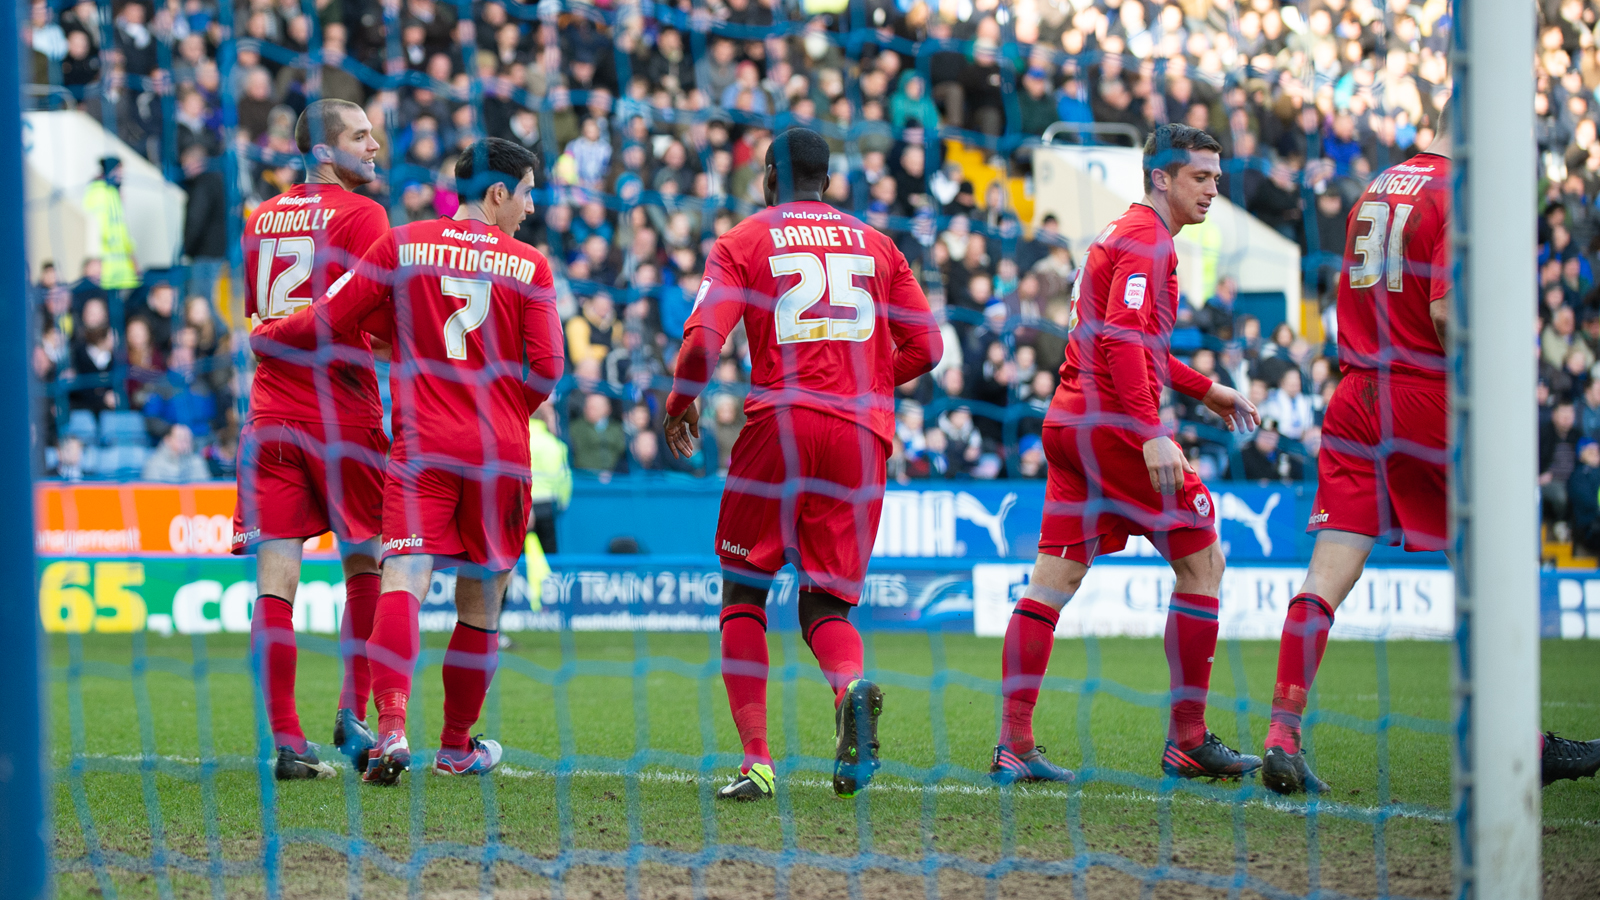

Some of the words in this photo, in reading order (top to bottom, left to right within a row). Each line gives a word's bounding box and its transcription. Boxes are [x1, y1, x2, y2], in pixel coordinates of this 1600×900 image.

[1367, 173, 1433, 196] NUGENT
[1391, 164, 1436, 174] Malaysia
[277, 193, 322, 206] Malaysia
[254, 208, 336, 235] CONNOLLY
[782, 211, 842, 222] Malaysia
[441, 228, 499, 245] Malaysia
[769, 225, 866, 249] BARNETT
[1349, 201, 1414, 293] 31
[257, 236, 315, 321] 12
[399, 242, 536, 285] WHITTINGHAM
[768, 252, 876, 344] 25
[440, 275, 492, 360] 7
[169, 514, 234, 554] 080
[577, 571, 654, 604] TRAIN
[655, 571, 677, 604] 2
[1255, 577, 1433, 614] RULTS
